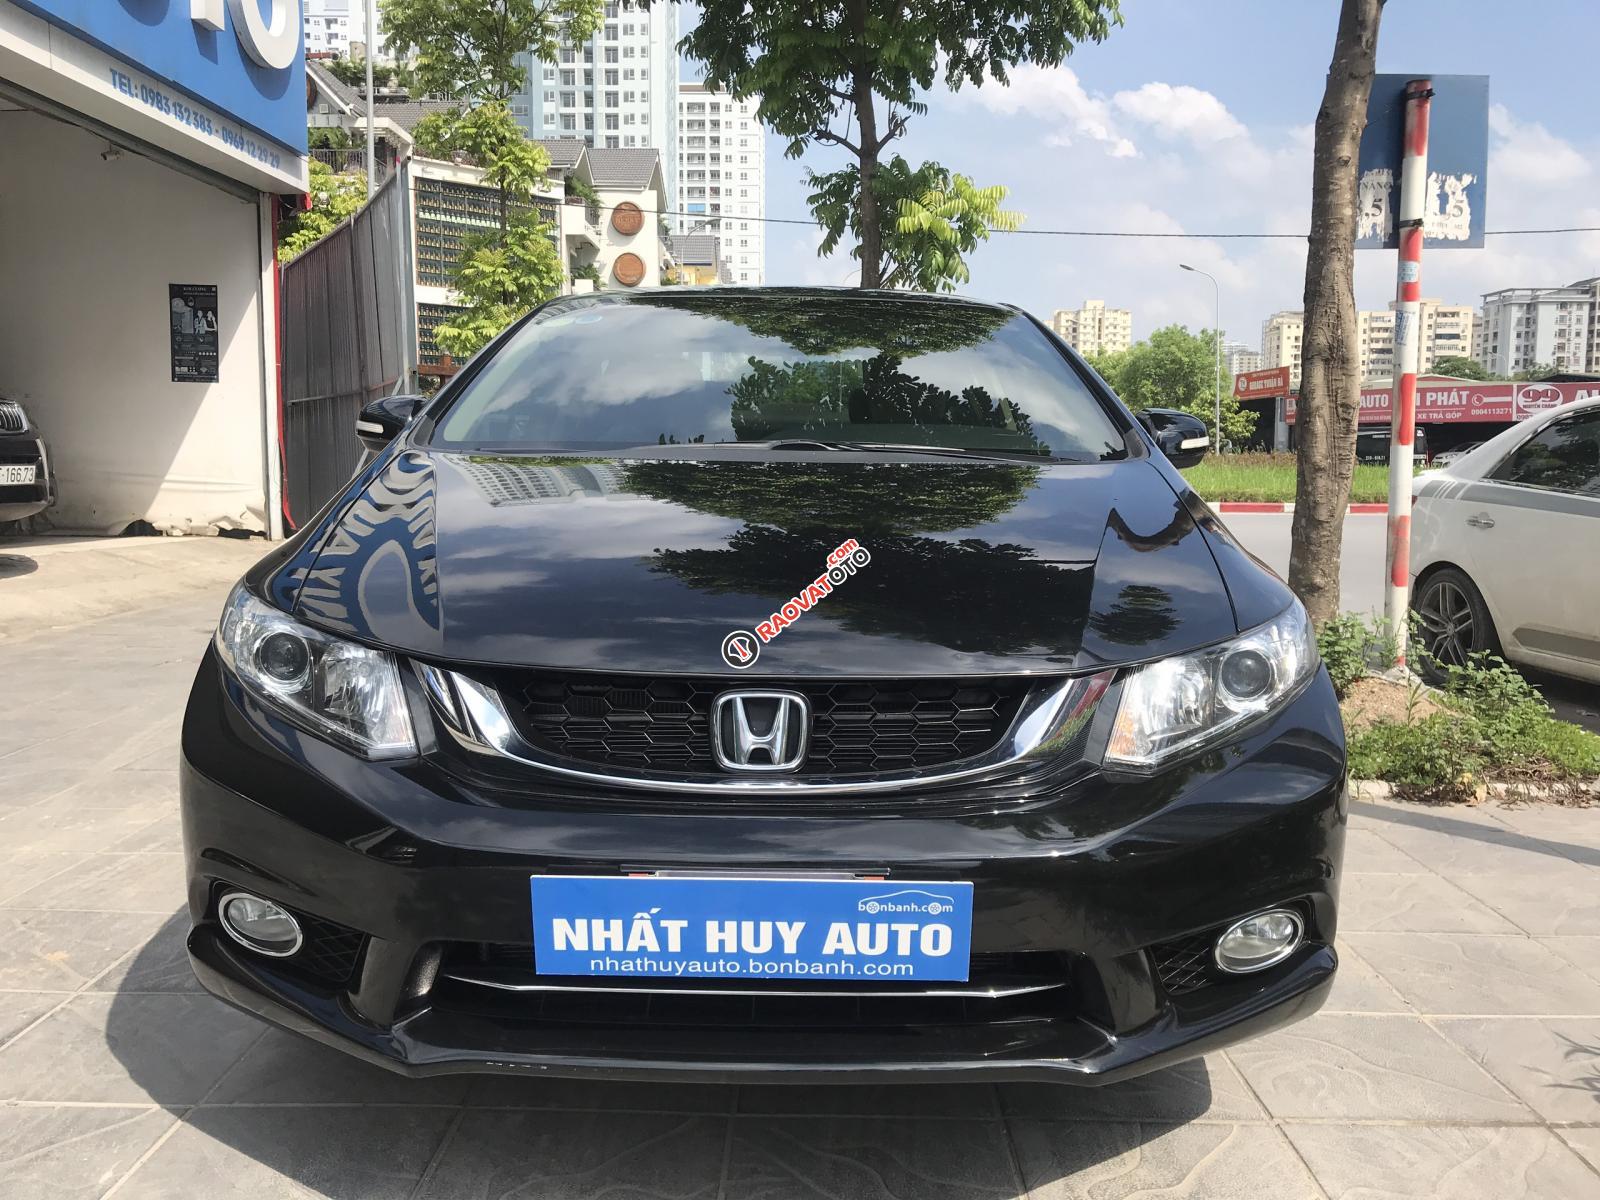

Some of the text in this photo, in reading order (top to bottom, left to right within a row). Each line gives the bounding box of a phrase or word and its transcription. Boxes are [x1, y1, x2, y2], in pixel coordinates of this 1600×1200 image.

[110, 68, 138, 98] TEL:
[1360, 394, 1389, 408] AUTO
[1426, 388, 1469, 406] PHÁT
[858, 901, 953, 915] bonbanh.com
[552, 907, 952, 957] NHẤT HUY AUTO
[590, 956, 914, 976] nhathuyauto.bonbanh.com
